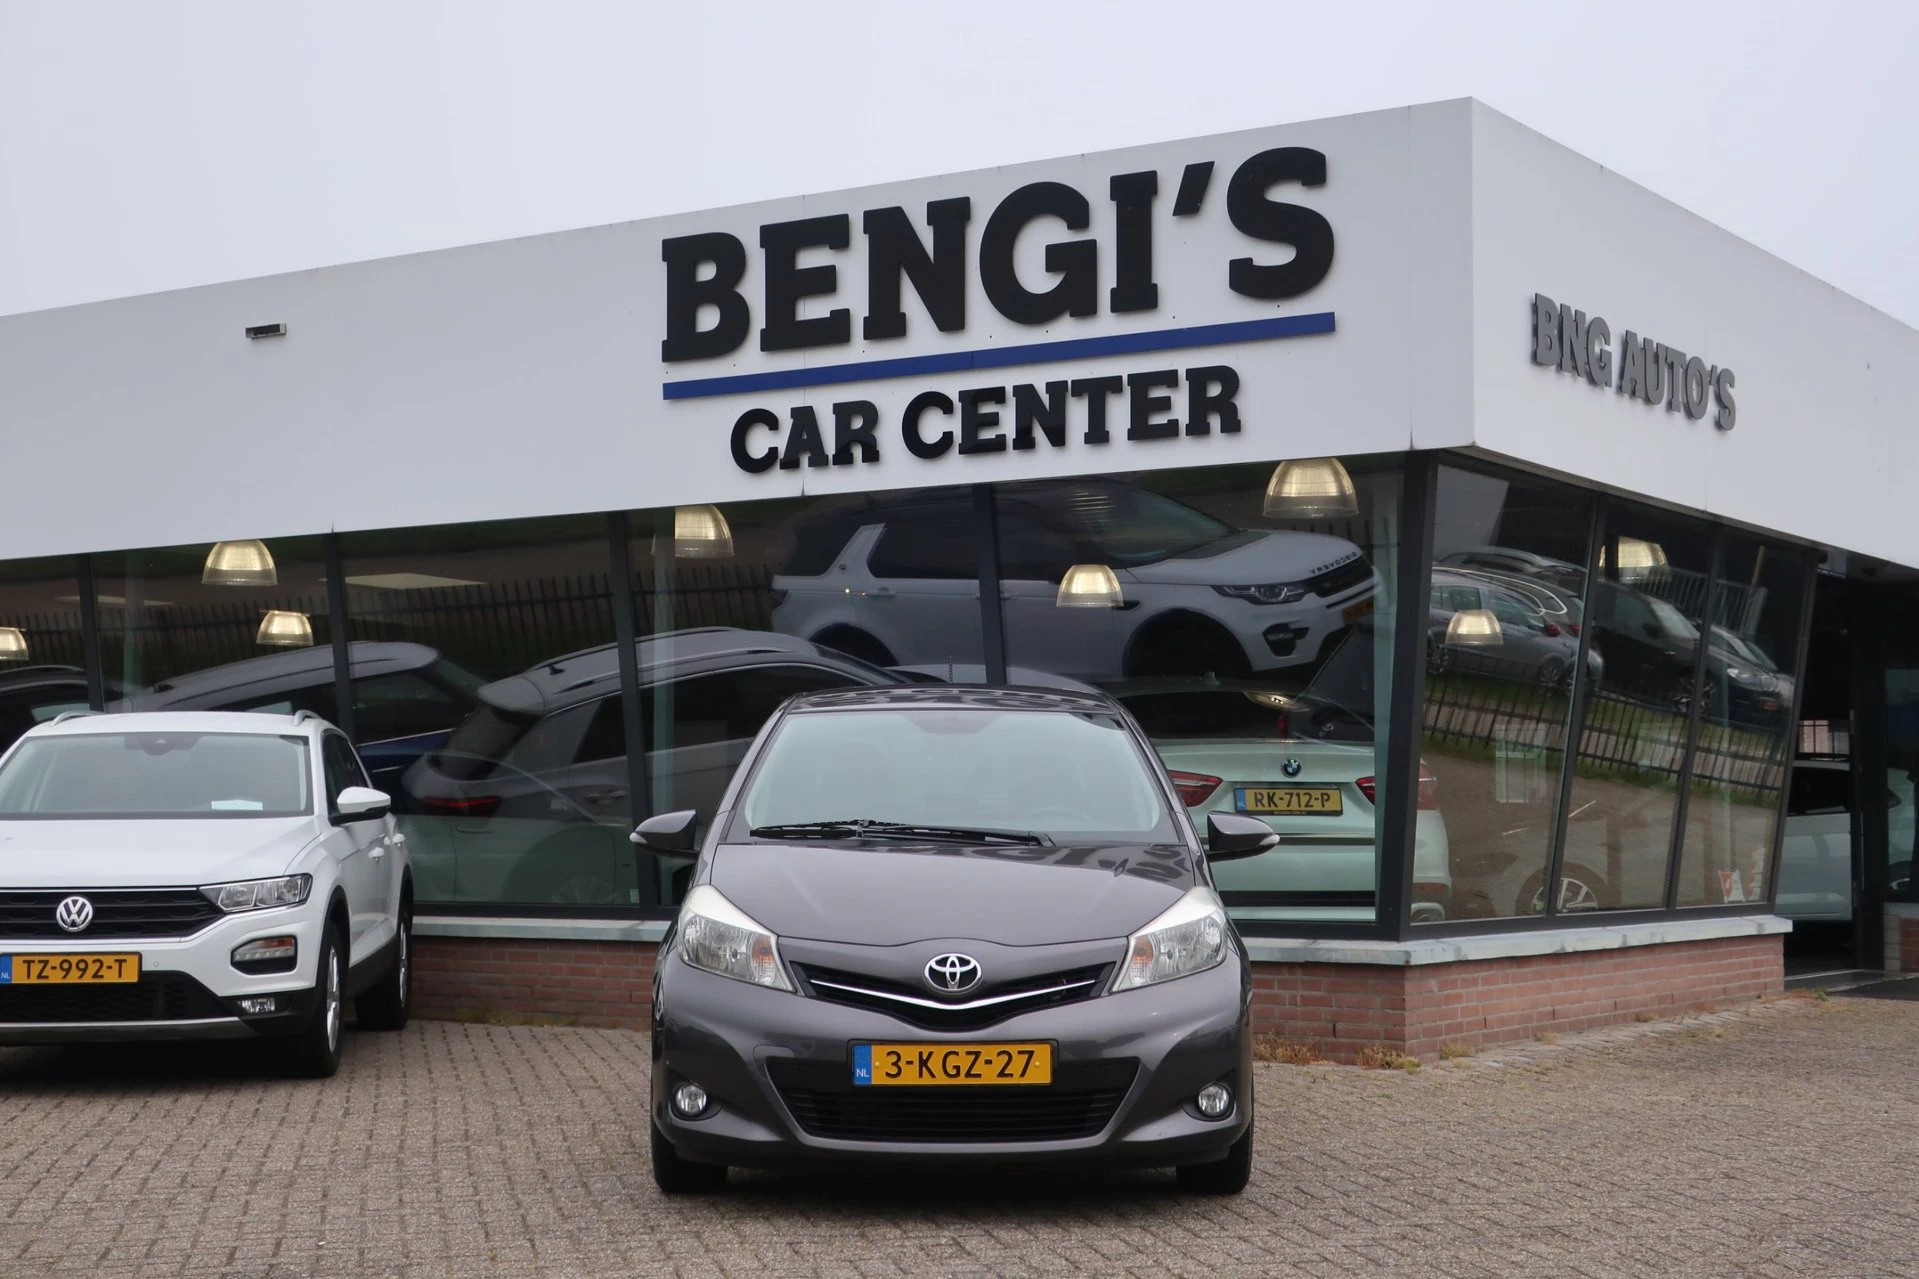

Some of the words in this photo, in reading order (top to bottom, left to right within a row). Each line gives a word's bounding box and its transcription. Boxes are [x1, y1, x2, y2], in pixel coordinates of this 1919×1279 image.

[662, 146, 1335, 363] BENGI'S
[1533, 292, 1612, 388] BNG
[1619, 329, 1736, 431] AUTO'S
[730, 399, 880, 474] CAR
[901, 365, 1242, 459] CENTER
[1254, 792, 1330, 808] RK-712-P
[22, 959, 127, 980] TZ-992-T
[856, 1069, 869, 1078] NL
[885, 1050, 1035, 1079] 3-KGZ-27
